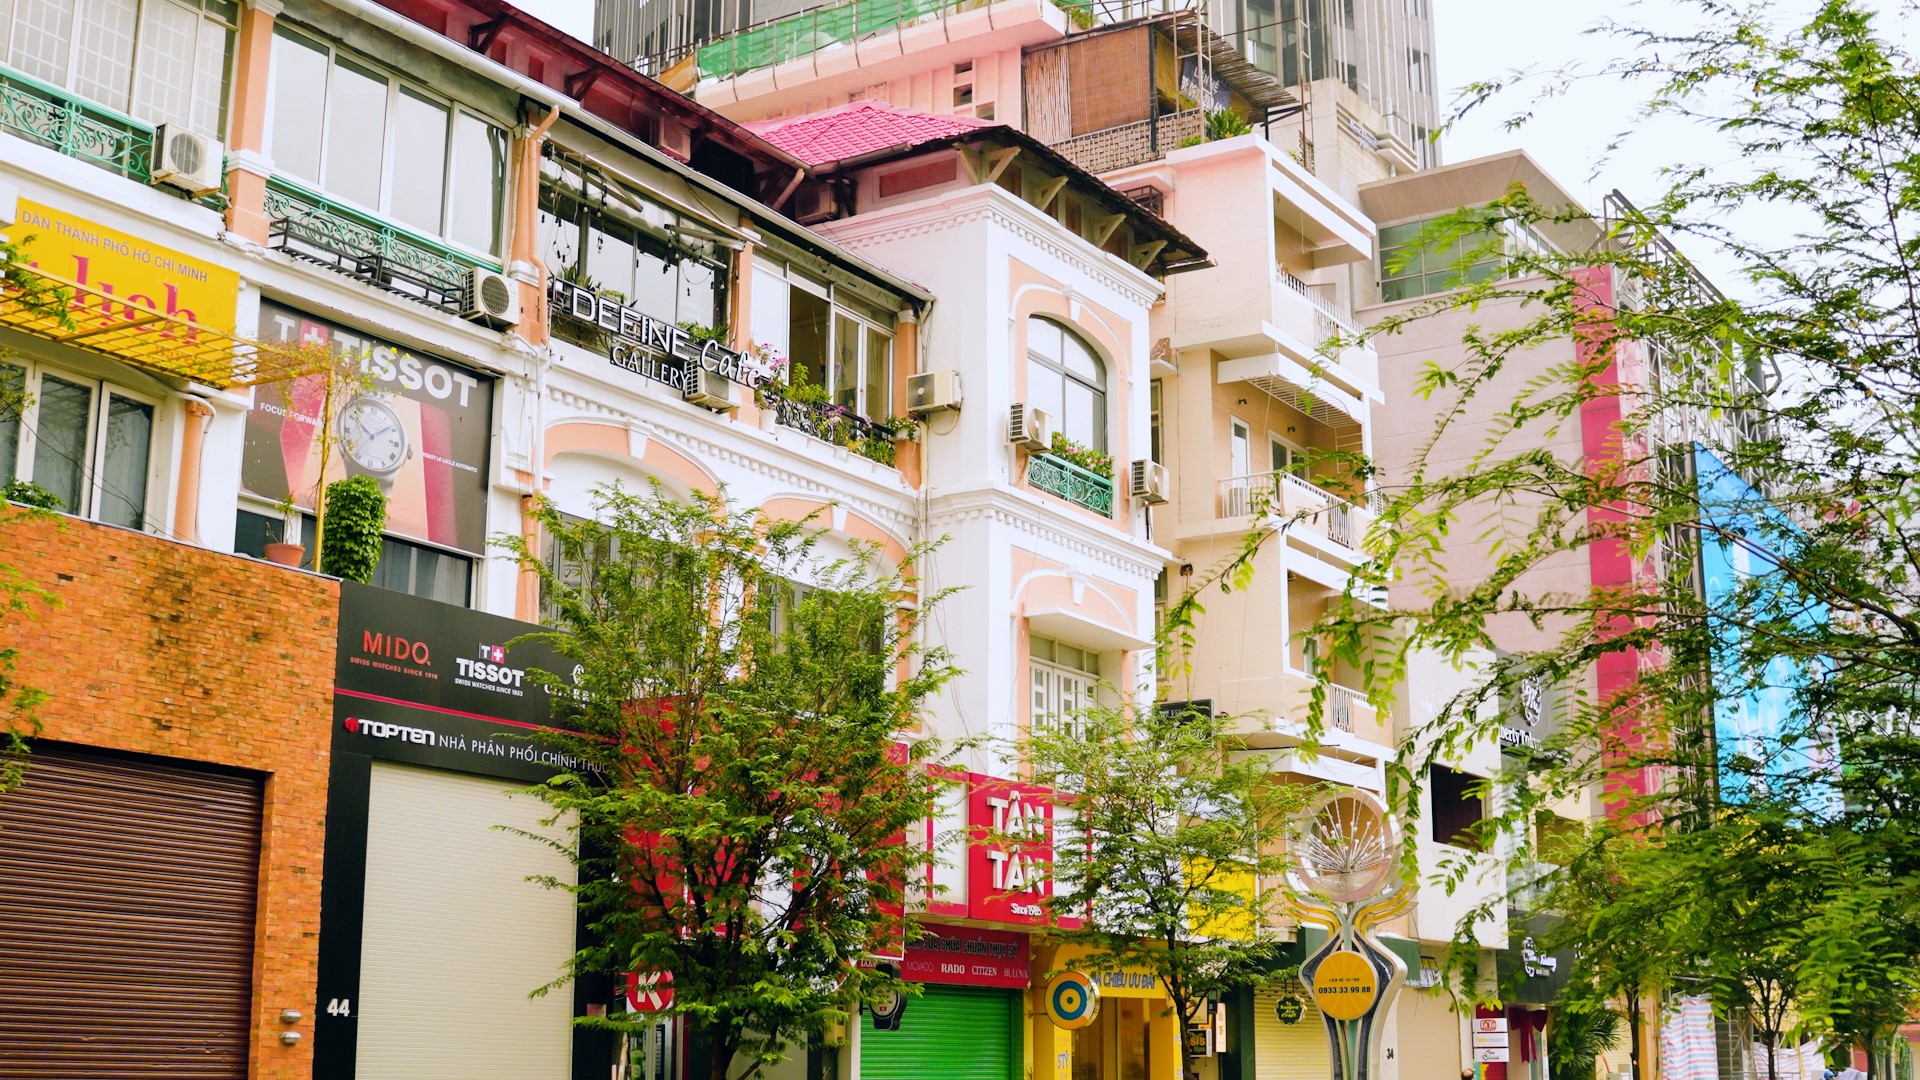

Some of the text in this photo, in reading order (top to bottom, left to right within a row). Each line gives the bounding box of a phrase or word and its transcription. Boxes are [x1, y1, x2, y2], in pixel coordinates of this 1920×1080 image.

[22, 209, 51, 231] DÂN
[55, 221, 99, 247] THÀNH
[103, 233, 130, 256] PHỐ
[133, 246, 151, 265] HỒ
[154, 254, 174, 273] CHÍ
[178, 263, 208, 283] MINH
[572, 287, 690, 361] DEFINE
[333, 329, 478, 408] TISSOT
[612, 346, 689, 391] GALLERY
[260, 402, 288, 417] FOCUS
[362, 630, 430, 665] MIDO
[372, 661, 401, 673] WATCHES
[403, 667, 423, 677] SINCE
[456, 657, 525, 688] TISSOT
[471, 681, 496, 692] WATCHES
[496, 686, 512, 695] SINCE
[439, 733, 467, 752] NHÀ
[471, 738, 505, 759] PHÂN
[509, 745, 538, 763] PHỐI
[541, 750, 577, 769] CHÍNH
[987, 790, 1044, 843] TÂN
[941, 963, 966, 975] RADO
[971, 965, 998, 977] CITIZEN
[1003, 968, 1029, 979] BULOVA
[1318, 986, 1337, 994] 0933
[1339, 986, 1349, 994] 33
[1361, 985, 1371, 993] 88
[327, 998, 351, 1017] 44
[1386, 1047, 1394, 1060] 34
